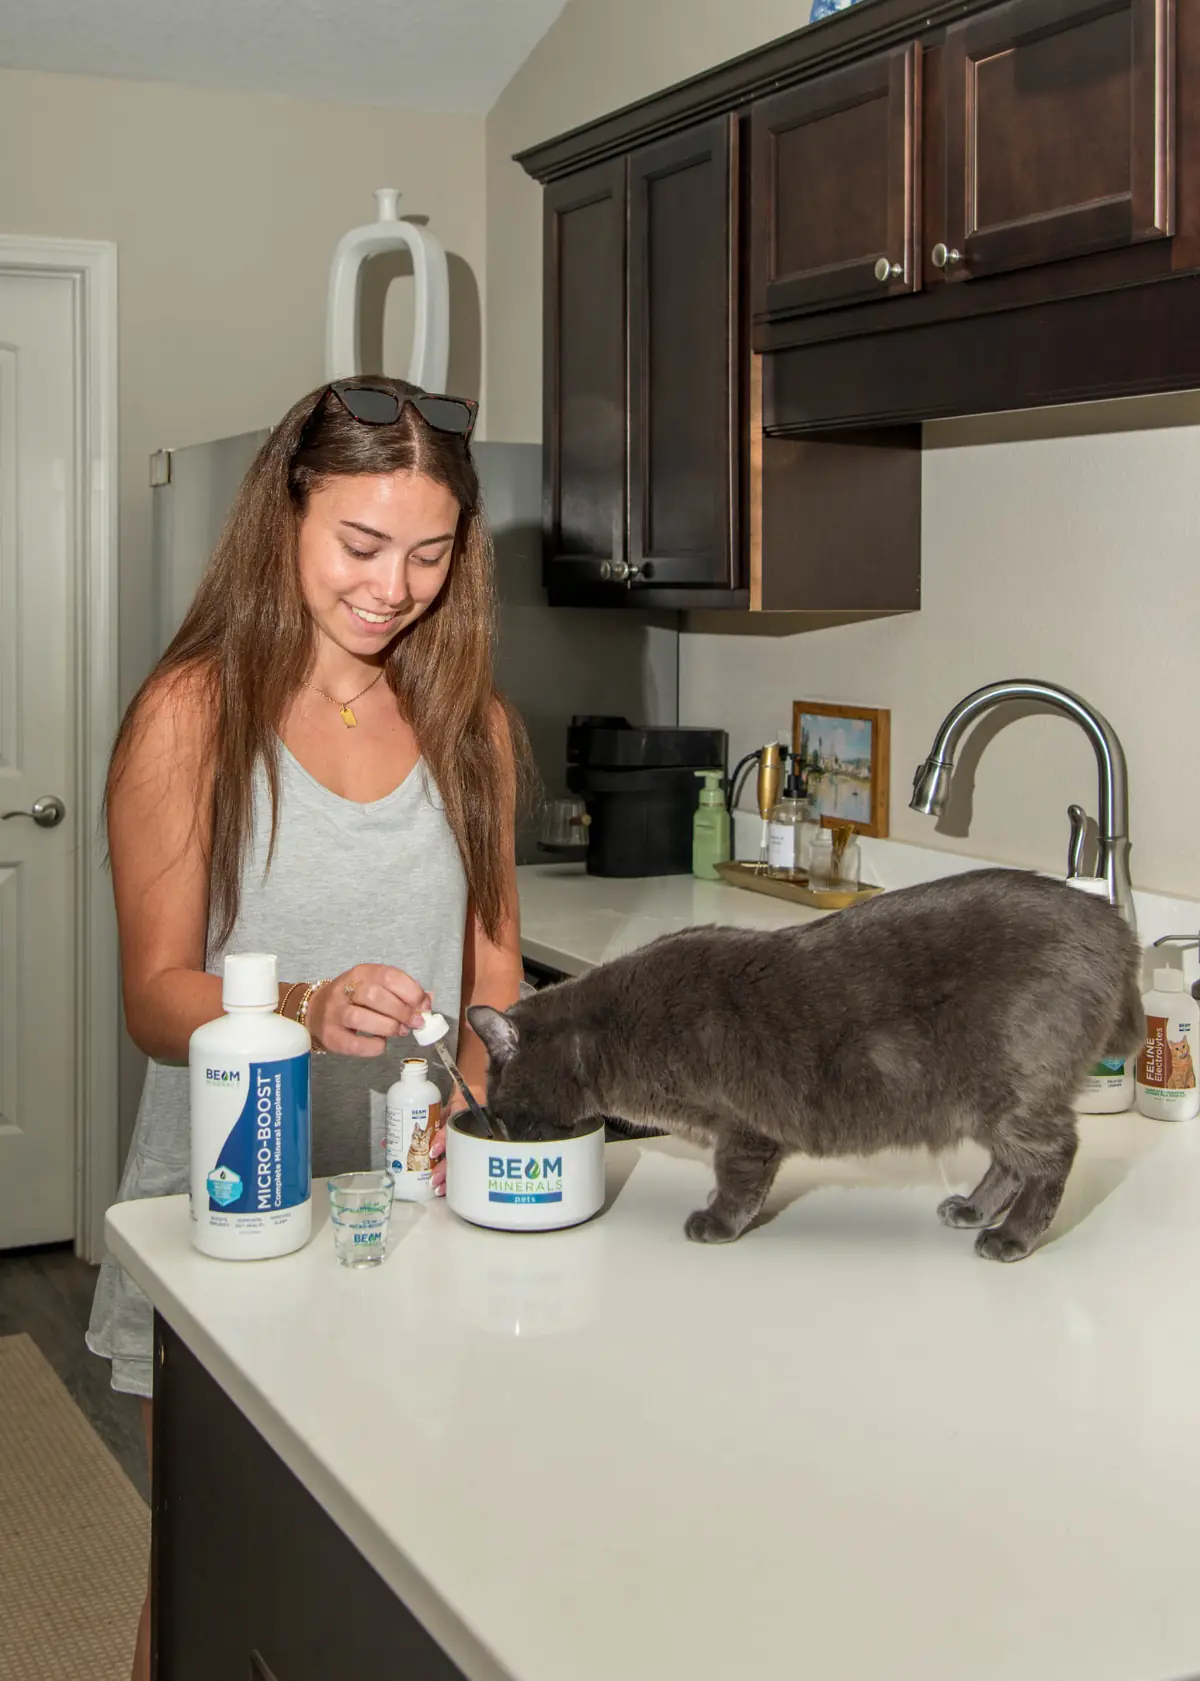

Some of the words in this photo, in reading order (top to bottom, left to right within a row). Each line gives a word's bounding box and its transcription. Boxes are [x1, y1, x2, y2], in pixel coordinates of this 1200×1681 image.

[1146, 1037, 1155, 1081] FELINE
[1155, 1027, 1163, 1082] Electrolytes
[274, 1073, 283, 1128] Supplement
[274, 1129, 282, 1163] Mineral
[274, 1163, 282, 1207] Complete
[488, 1179, 563, 1192] MINERALS
[514, 1194, 536, 1204] pets
